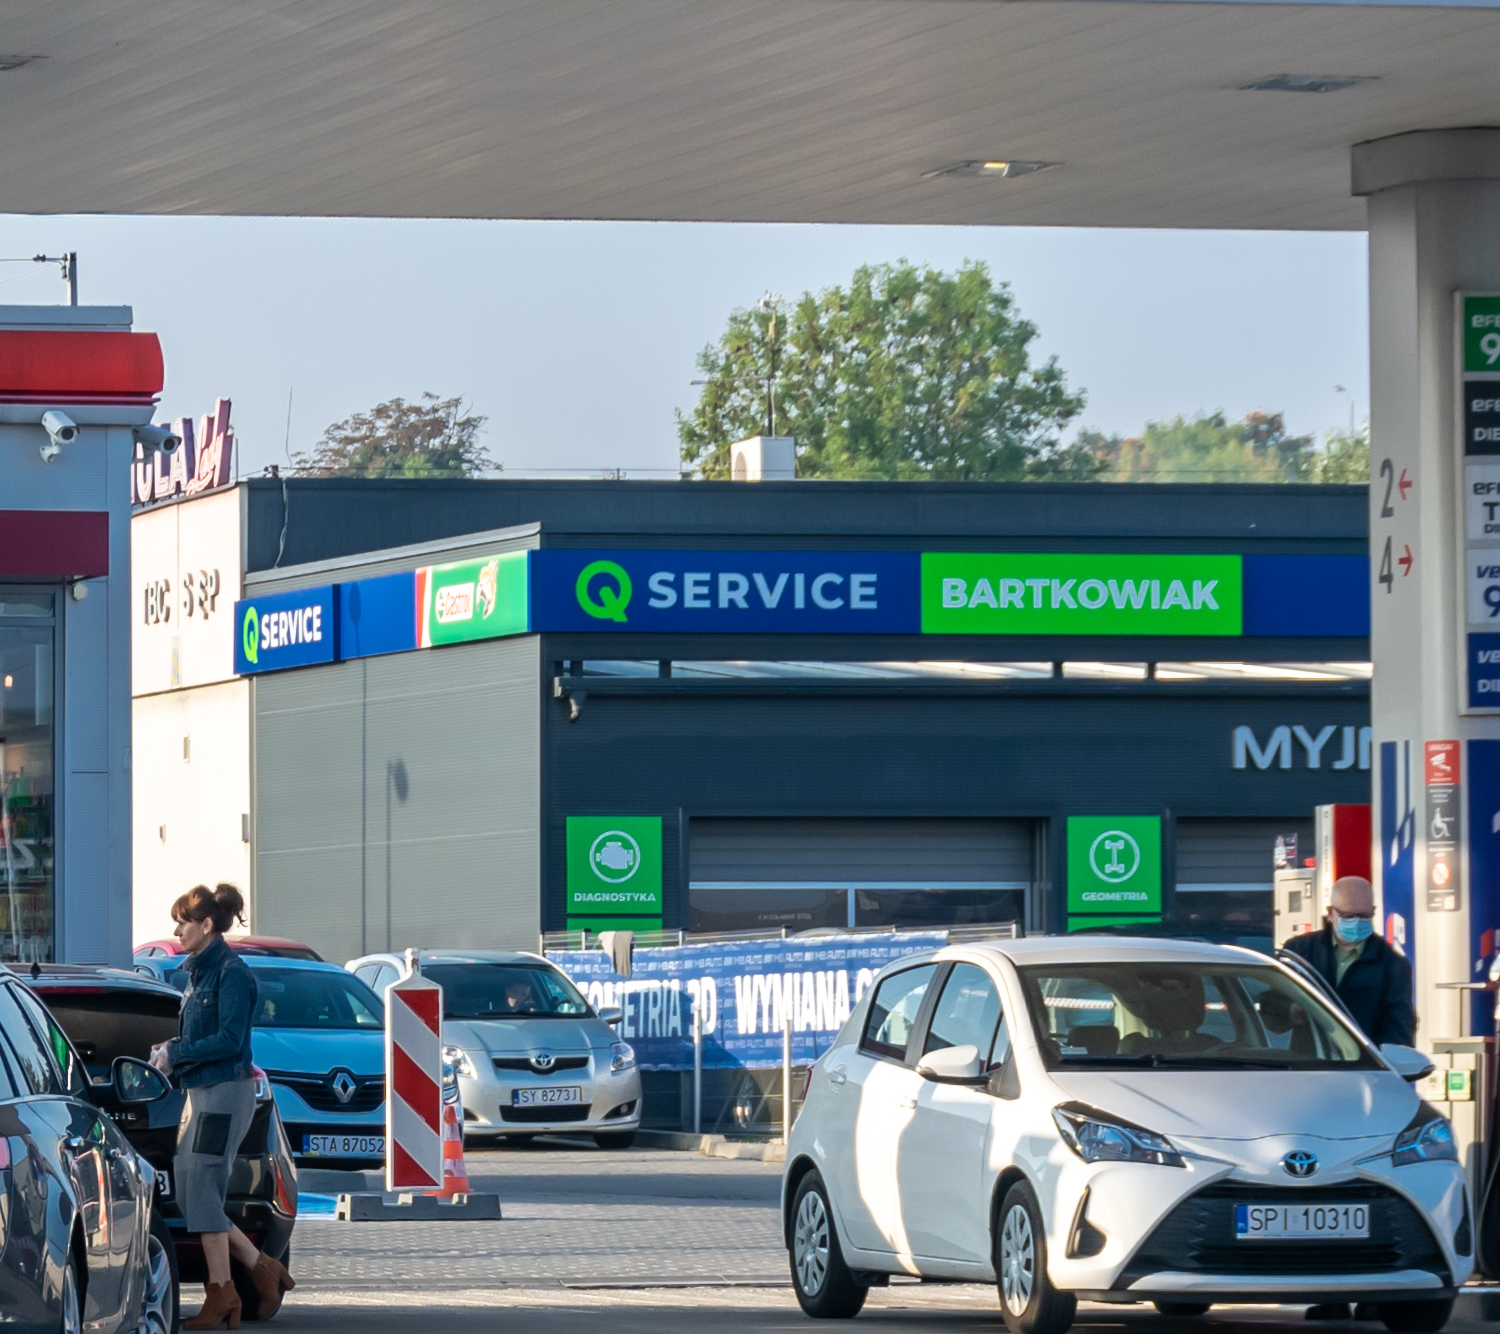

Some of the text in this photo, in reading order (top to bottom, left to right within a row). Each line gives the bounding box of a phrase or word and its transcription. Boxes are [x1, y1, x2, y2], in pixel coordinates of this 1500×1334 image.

[1380, 458, 1394, 518] 2
[1379, 535, 1393, 594] 4
[444, 590, 471, 616] Castrol
[575, 560, 878, 622] Q SERVICE
[942, 578, 1220, 610] BARTKOWIAK
[261, 605, 322, 650] SERVICE
[573, 892, 657, 902] DIAGNOSTYKA
[1082, 891, 1148, 902] GEOMETRIA
[735, 969, 851, 1034] WYMIANA
[521, 1089, 577, 1103] SY 8273J
[311, 1137, 385, 1153] STA 87052
[1250, 1207, 1366, 1231] SPI 10310
